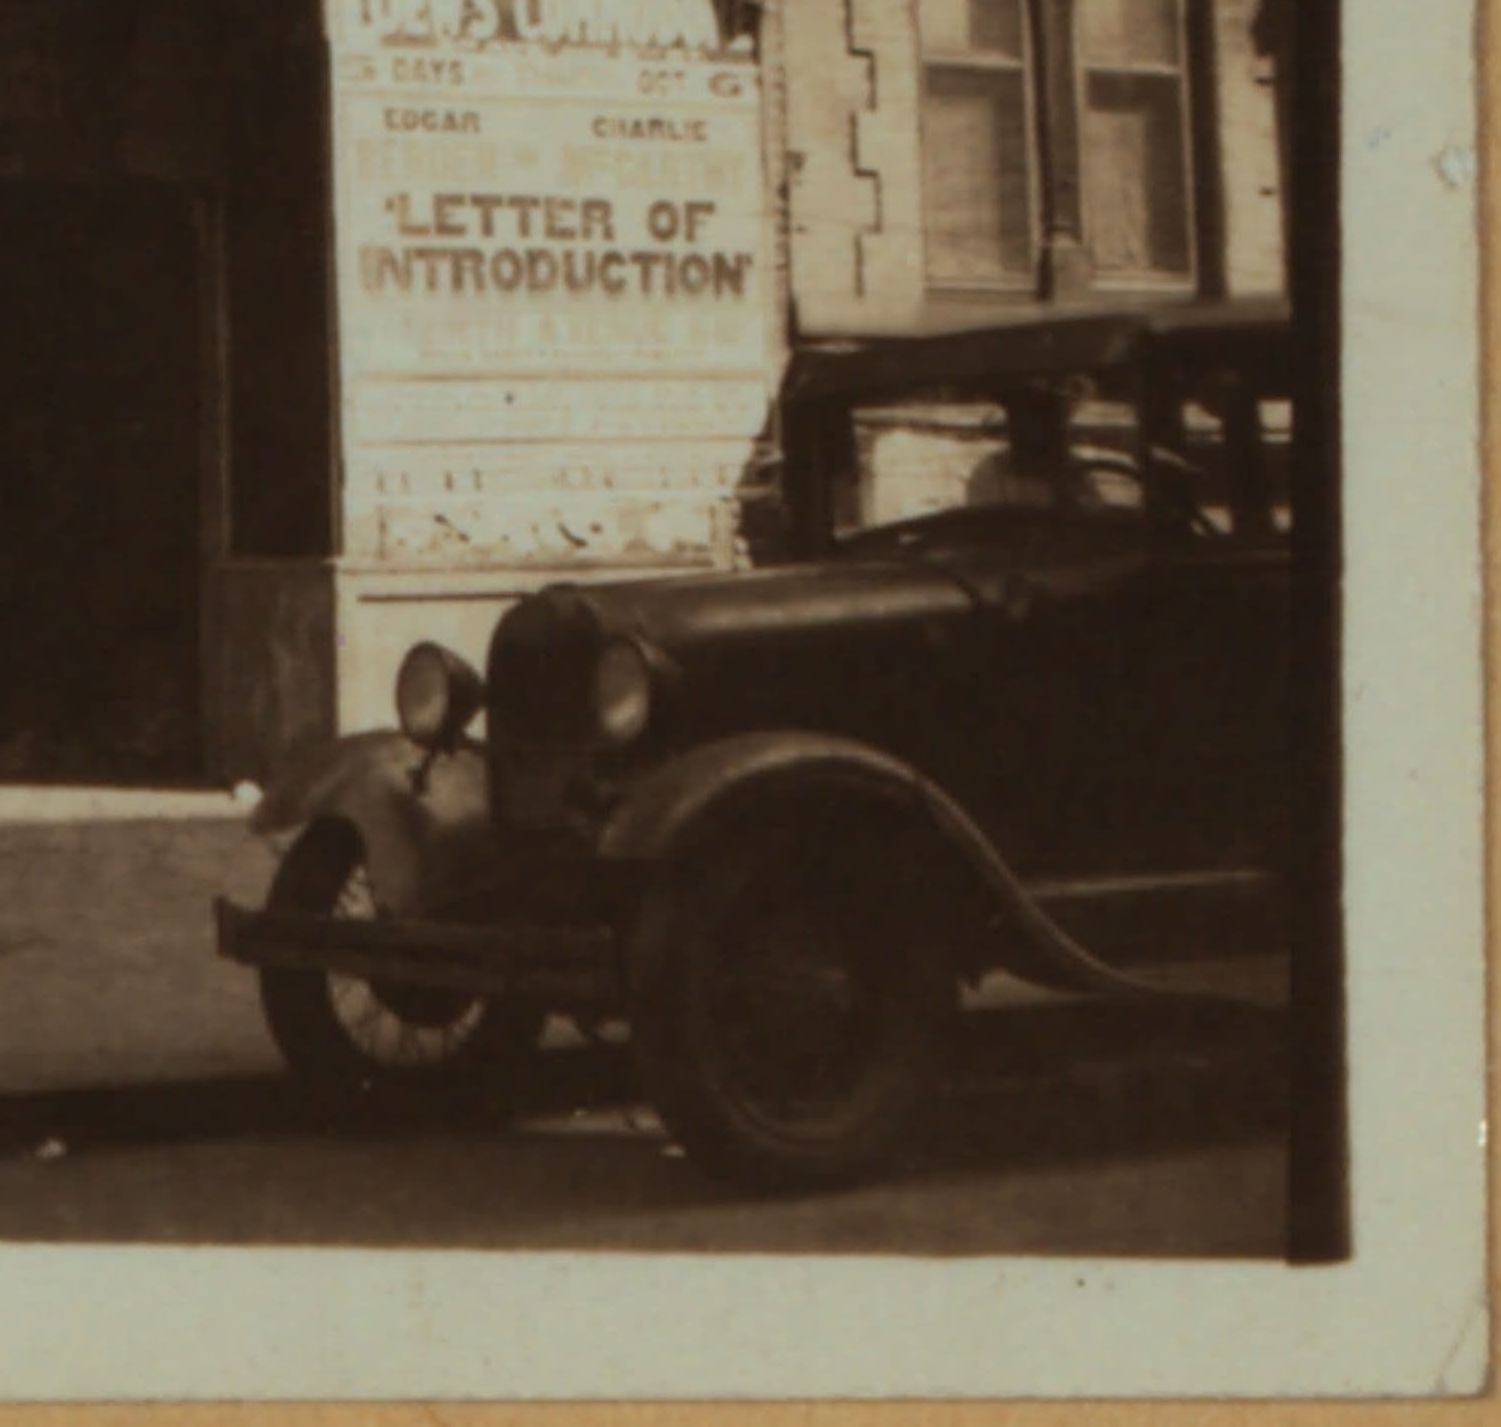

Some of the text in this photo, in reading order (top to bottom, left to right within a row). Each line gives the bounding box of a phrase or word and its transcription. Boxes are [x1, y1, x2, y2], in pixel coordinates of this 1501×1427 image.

[383, 106, 709, 143] EDGAR CHARLIE
[646, 200, 717, 243] OF
